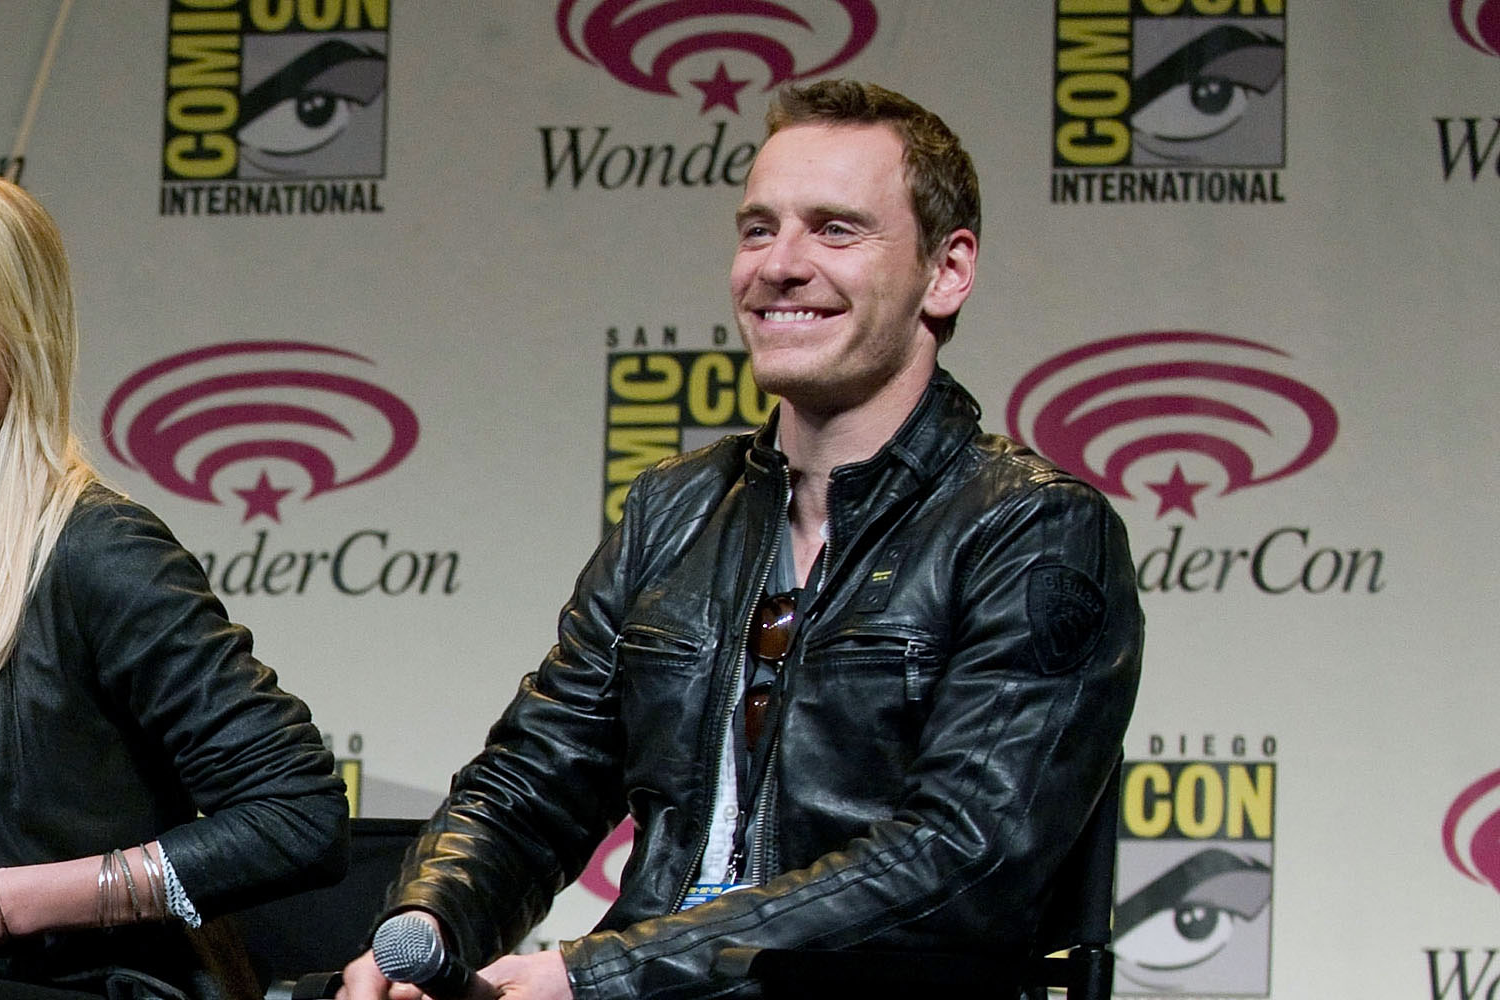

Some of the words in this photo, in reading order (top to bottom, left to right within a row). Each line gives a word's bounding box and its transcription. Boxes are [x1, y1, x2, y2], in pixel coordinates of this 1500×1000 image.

[165, 0, 242, 179] COMI
[538, 120, 757, 190] Wonde
[160, 183, 385, 216] INTERNATIONAL
[1051, 171, 1286, 203] INTERNATIONAL
[605, 326, 677, 347] SAN
[1137, 525, 1387, 595] derCon
[1149, 733, 1278, 756] DIEGO
[1123, 762, 1275, 839] CON
